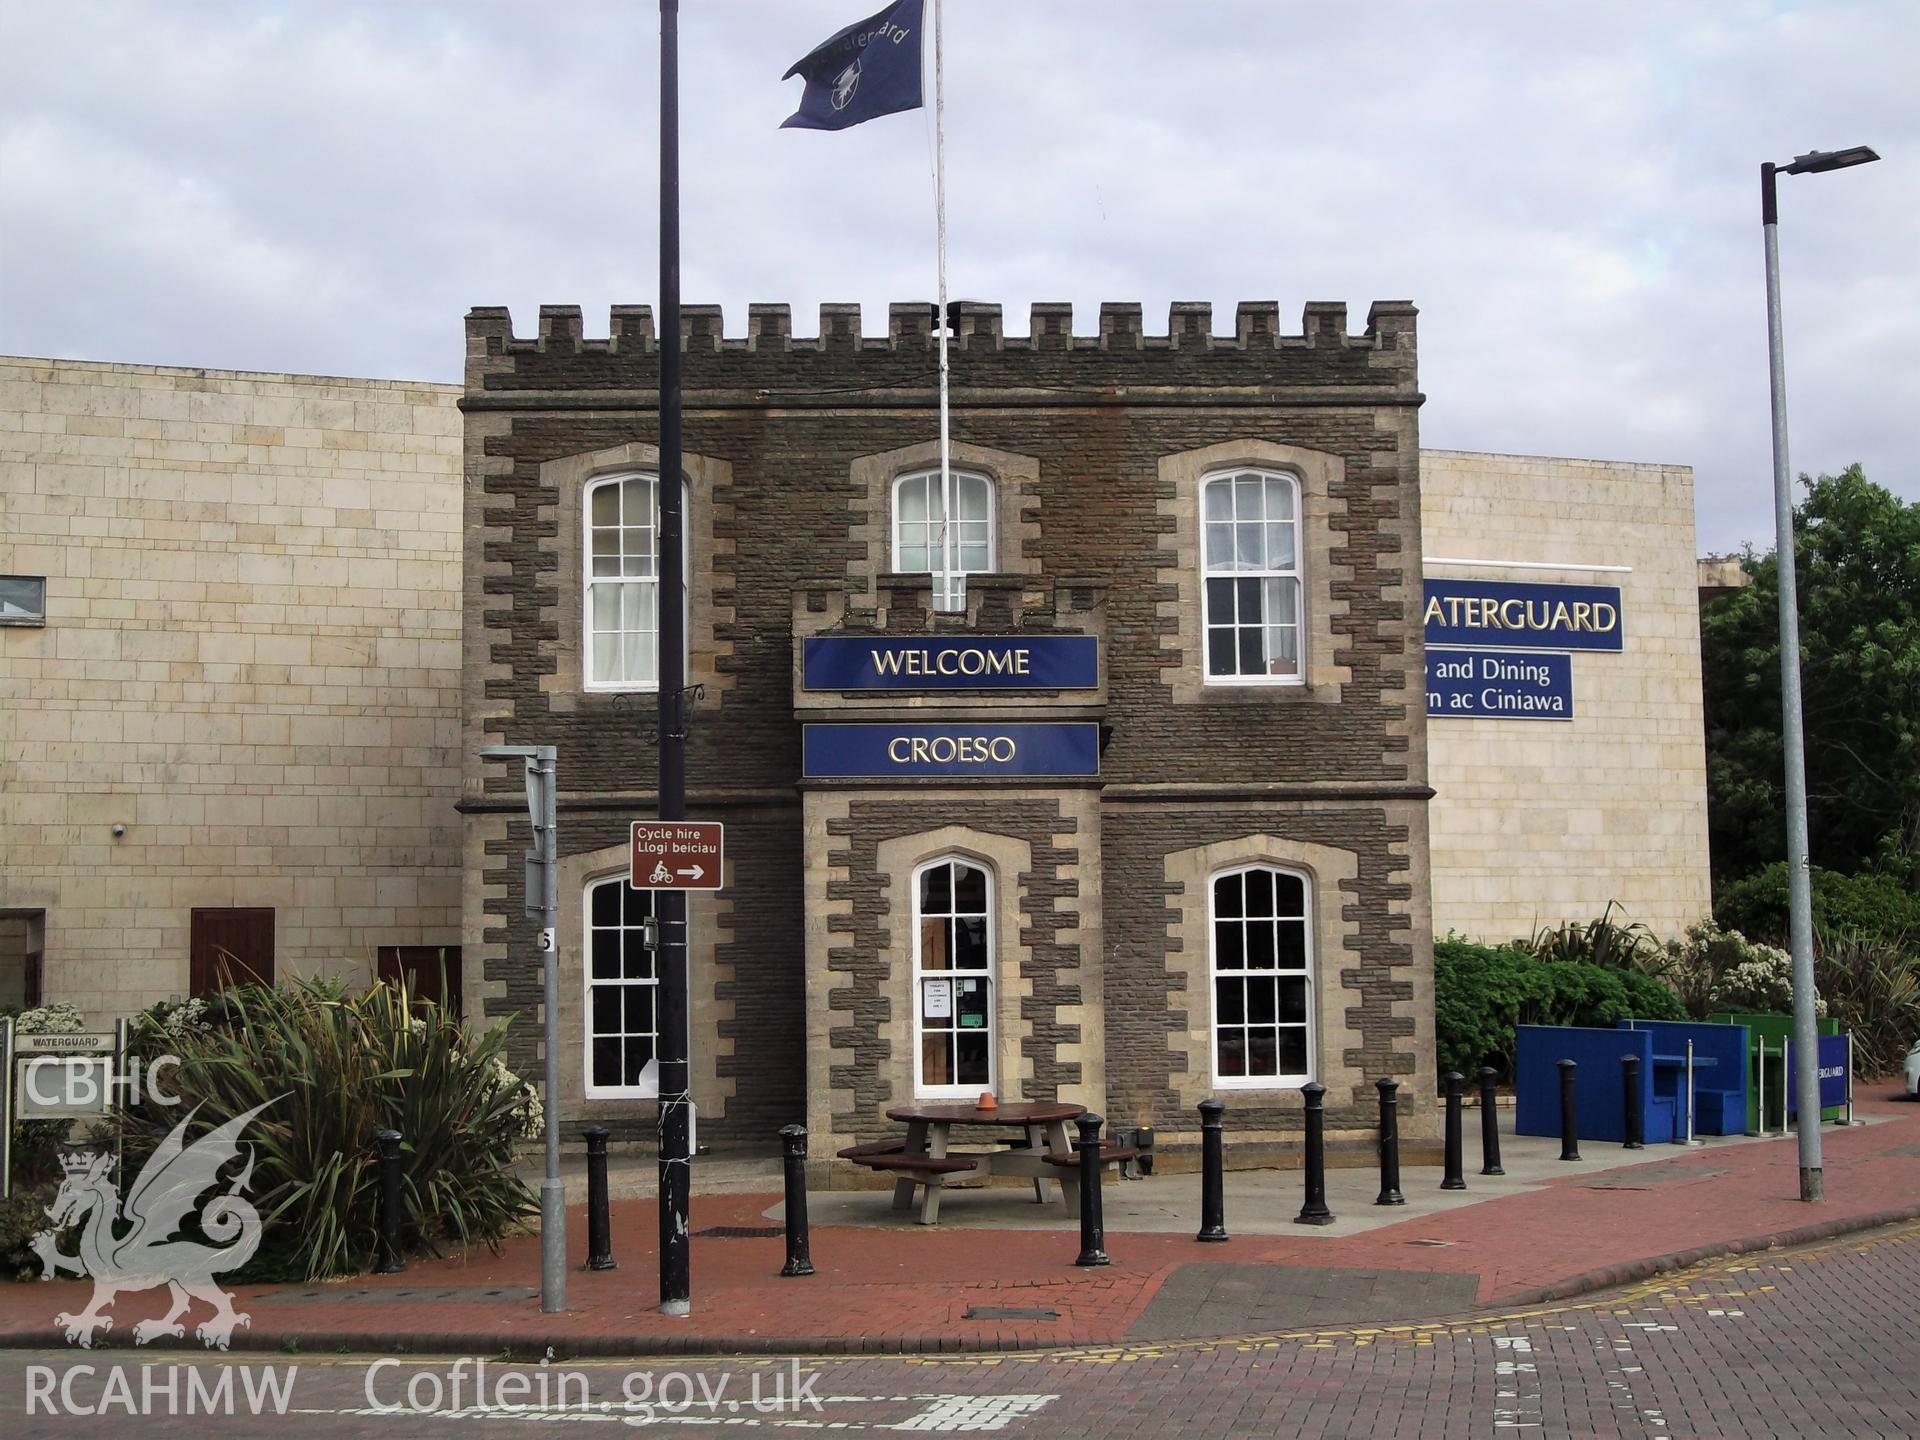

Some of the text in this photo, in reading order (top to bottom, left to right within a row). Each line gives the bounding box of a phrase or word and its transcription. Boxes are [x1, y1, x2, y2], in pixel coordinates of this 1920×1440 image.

[1423, 595, 1616, 632] ATERGUARD
[871, 649, 1030, 675] WELCOME
[1436, 656, 1474, 679] and
[1482, 658, 1551, 686] Dining
[1450, 692, 1474, 709] ac
[1481, 688, 1564, 711] Ciniawa
[888, 736, 1016, 763] CROESO
[637, 827, 701, 841] Cycle hire
[637, 841, 717, 855] Llogi beiciau
[32, 1037, 99, 1047] WATERGUARD
[1819, 1065, 1844, 1079] ERGUARD
